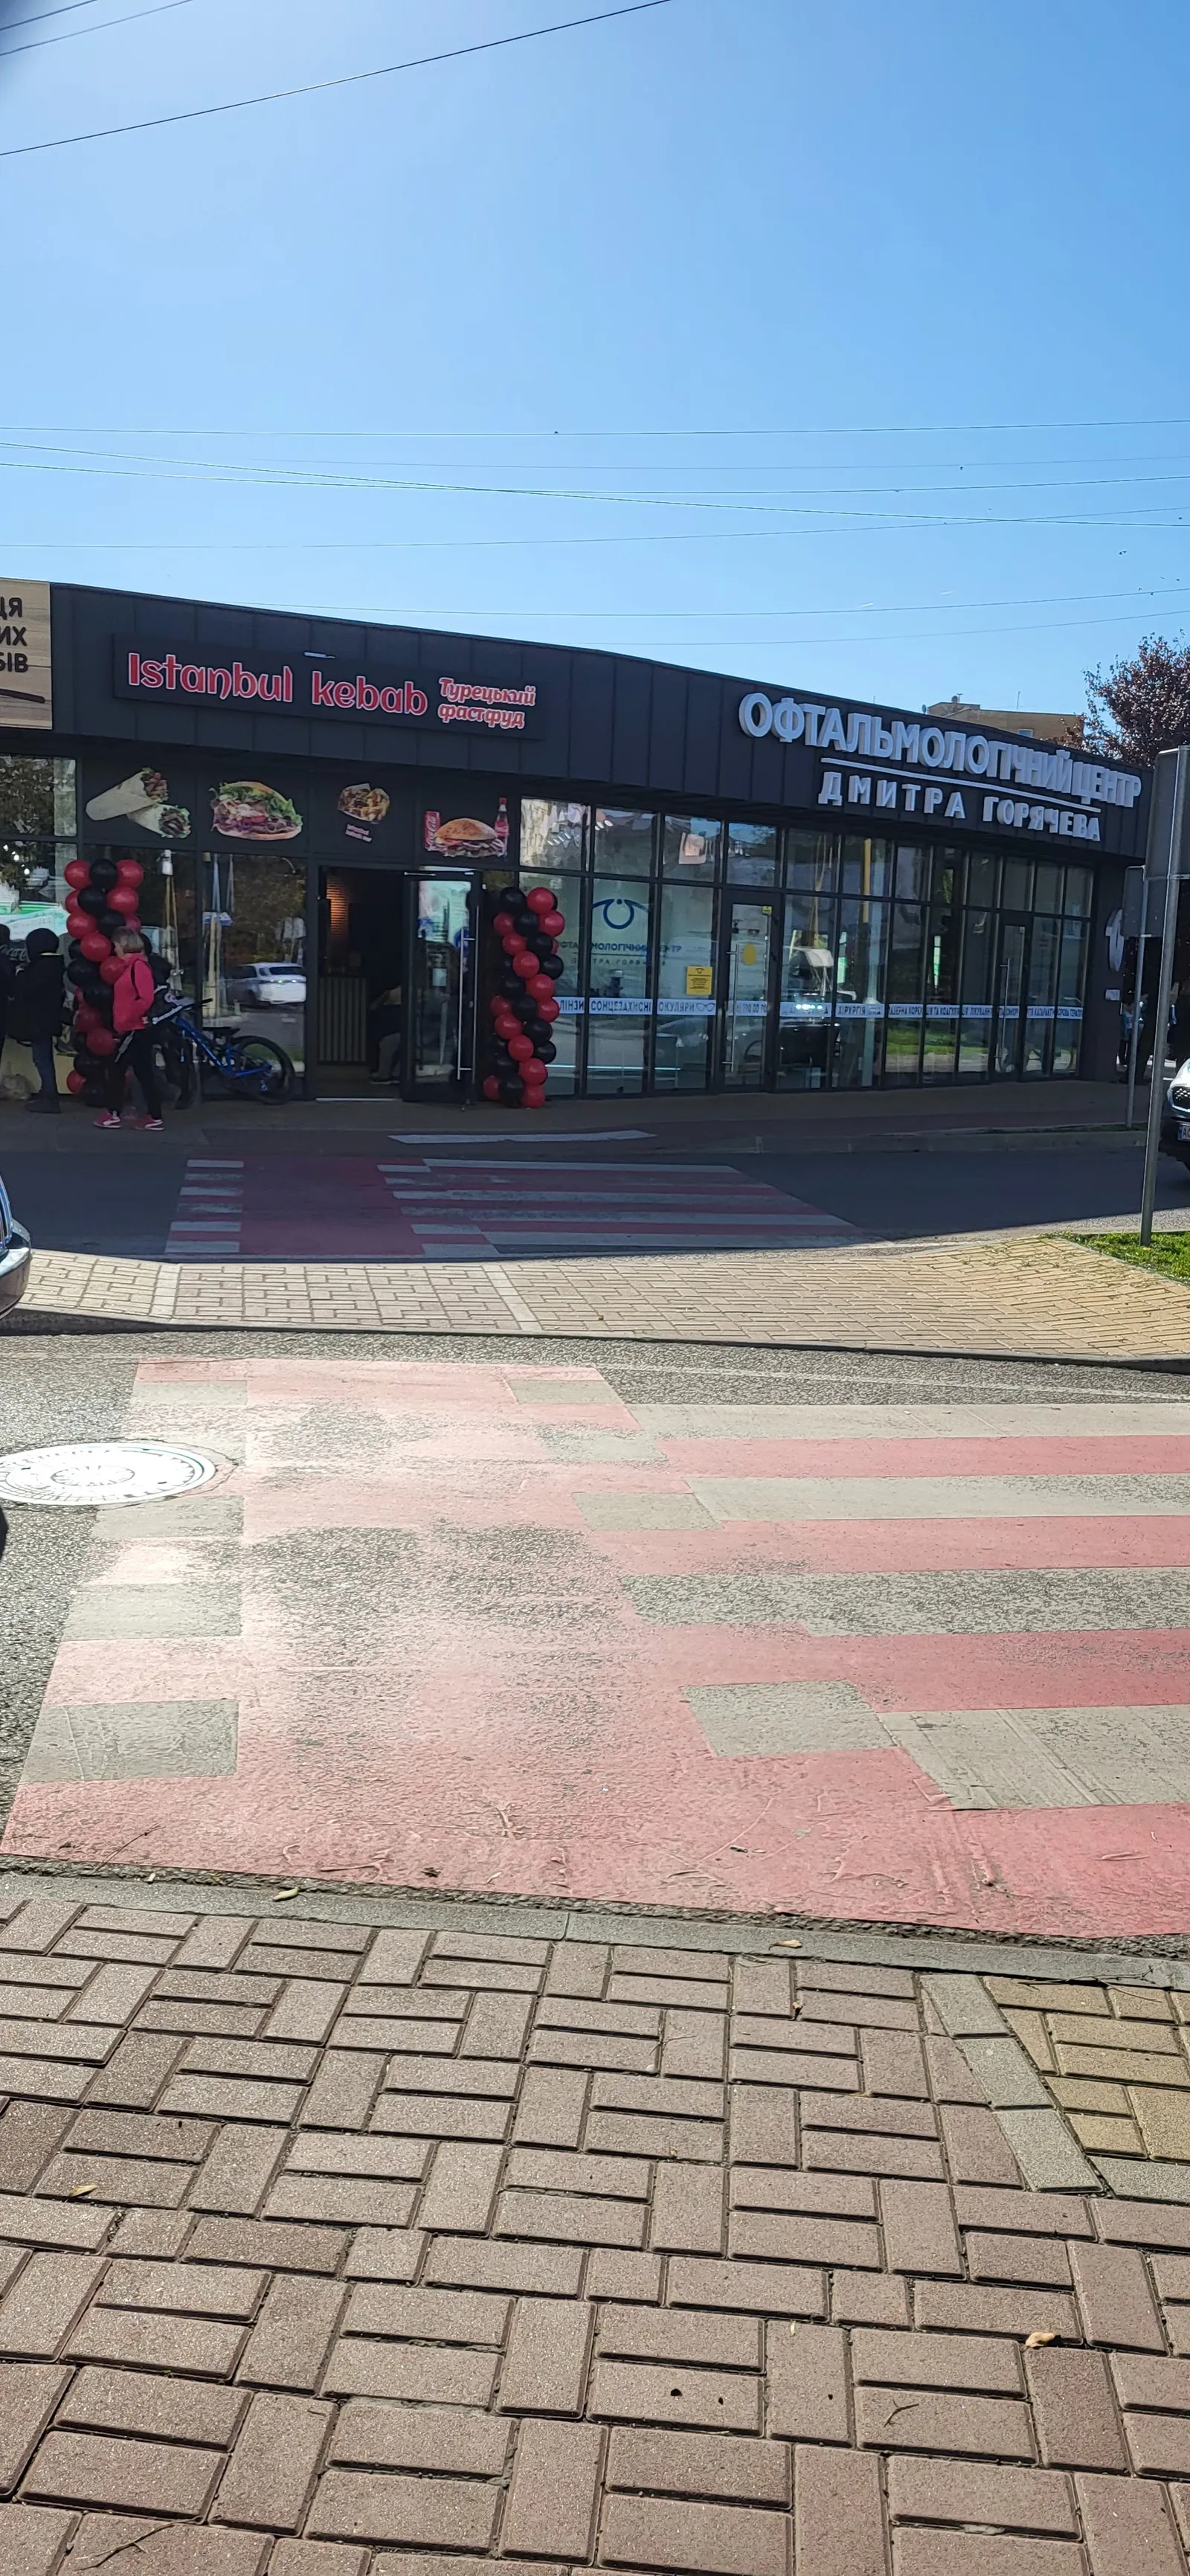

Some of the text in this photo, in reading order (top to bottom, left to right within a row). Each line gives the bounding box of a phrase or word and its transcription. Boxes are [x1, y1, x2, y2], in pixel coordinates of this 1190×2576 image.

[128, 652, 428, 716] Istanbul kebab
[438, 677, 537, 707] Турецький
[437, 703, 525, 730] фастфуд
[739, 692, 1142, 809] ОФТАЛЬМОЛОГІЧНИЙ ЦЕНТР
[817, 771, 1101, 842] ДМИТРА ГОРЯЧЕВА
[591, 1000, 695, 1012] СОНЦЕЗАХИСНІ ОКУЛЯРИ
[837, 1005, 866, 1015] ХІРУРГІЯ
